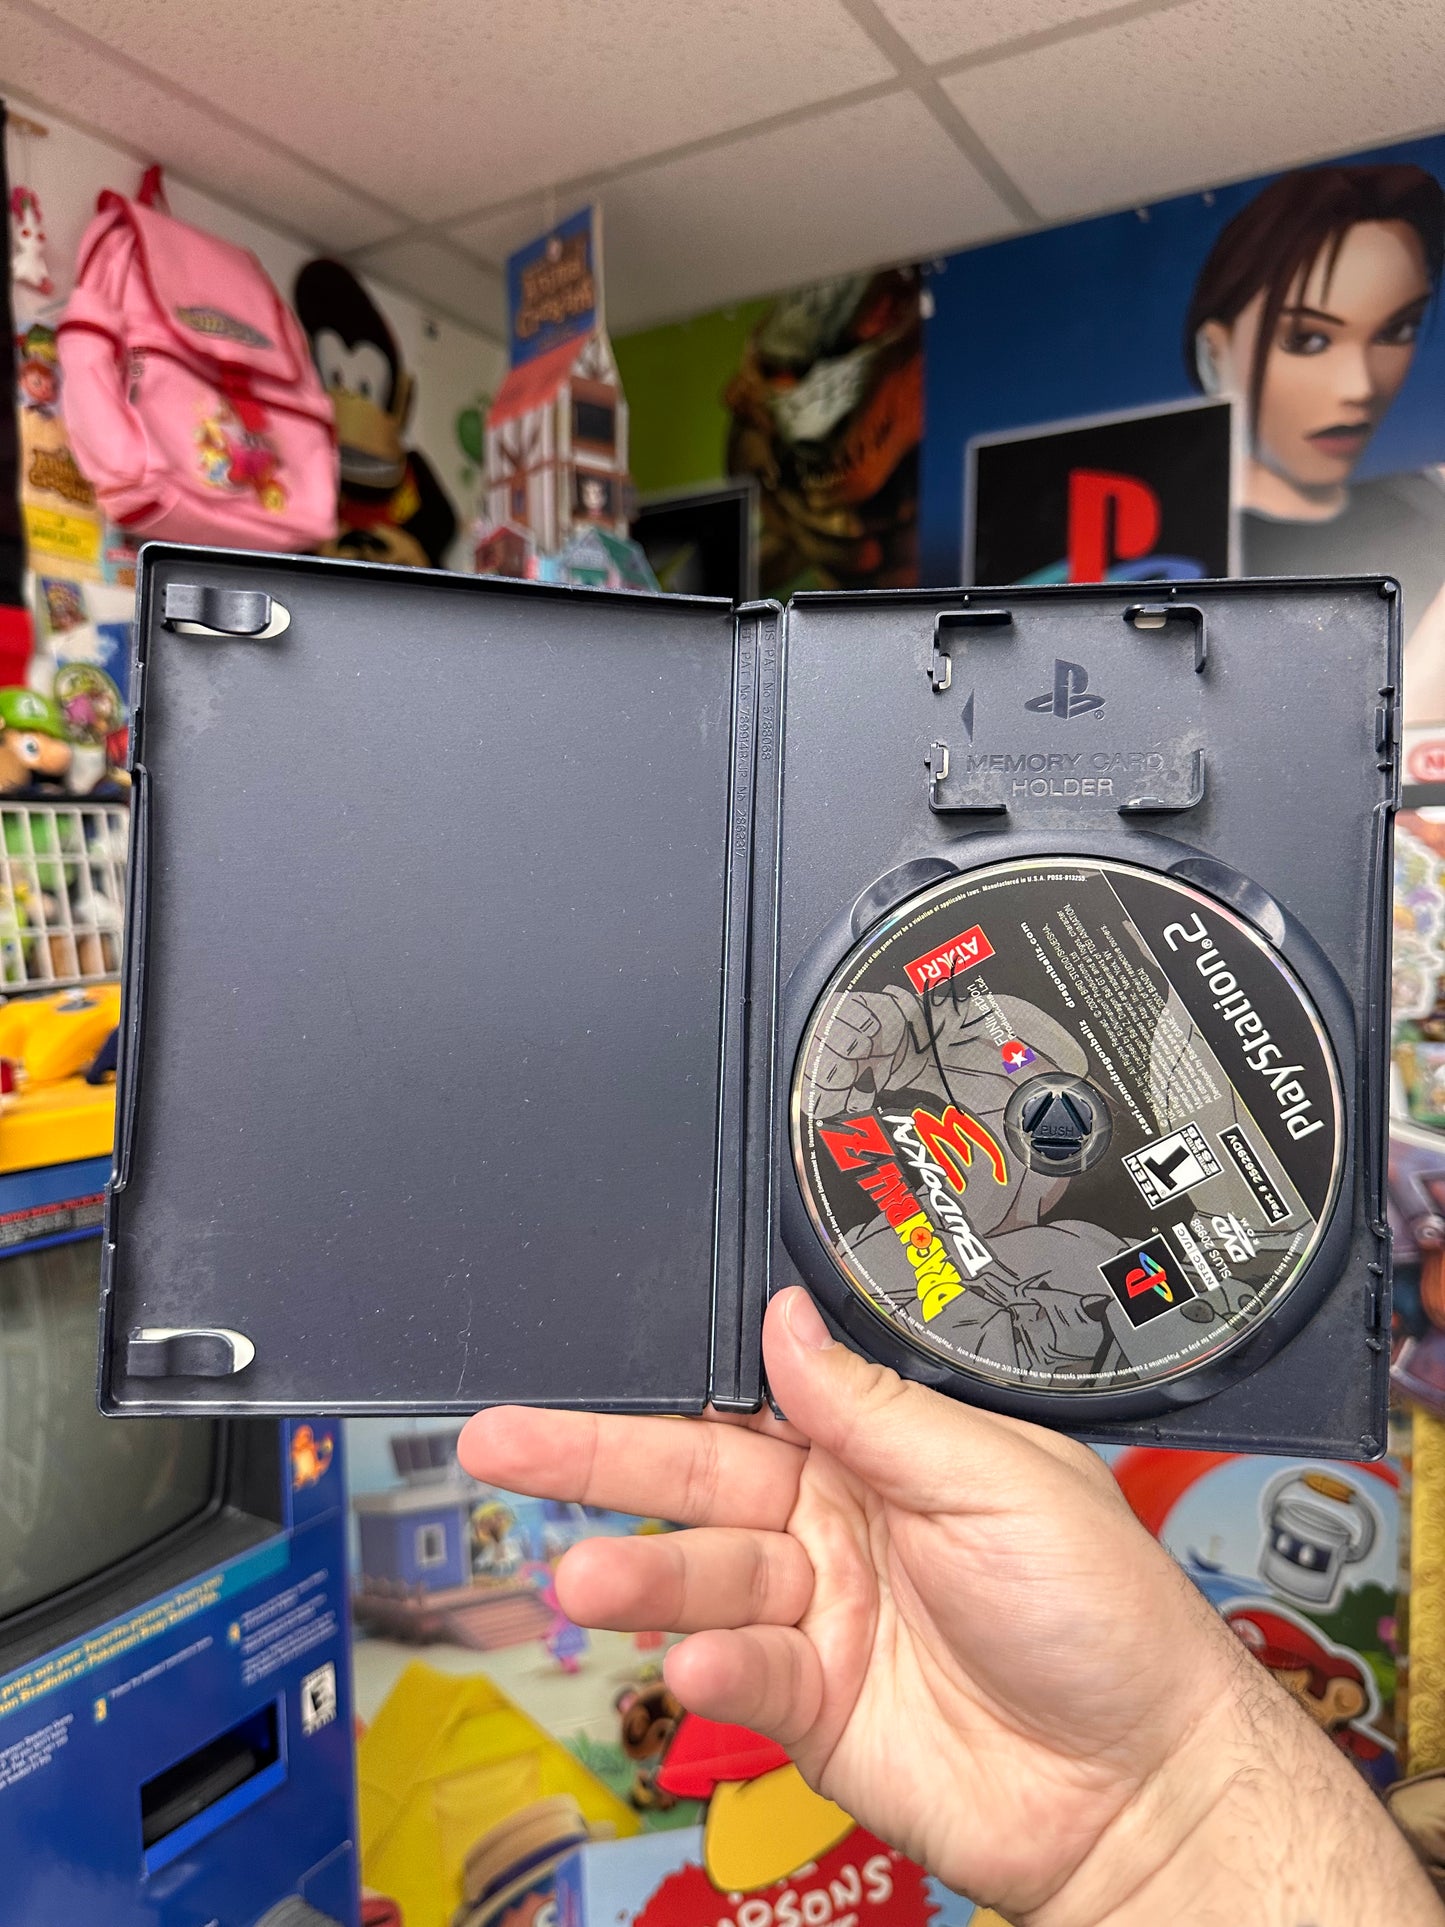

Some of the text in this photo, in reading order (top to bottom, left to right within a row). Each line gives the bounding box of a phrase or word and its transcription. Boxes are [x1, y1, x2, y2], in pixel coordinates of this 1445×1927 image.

[764, 624, 775, 641] US
[741, 652, 752, 674] PAT
[764, 650, 775, 671] PAT
[966, 752, 1164, 773] MEMORY CARD
[1011, 778, 1114, 797] HOLDER
[1055, 908, 1076, 938] character
[916, 935, 983, 982] ATARI
[1019, 921, 1076, 1009] dragonballz.com
[1092, 951, 1101, 960] of
[1088, 962, 1099, 975] and
[1097, 958, 1120, 991] trademarks
[974, 974, 988, 992] Ltd.
[1074, 978, 1088, 995] BIRD
[1101, 984, 1113, 998] Ball
[1118, 973, 1131, 989] New
[1083, 993, 1097, 1011] 2004
[1117, 990, 1127, 1001] are
[1139, 990, 1148, 1000] of
[1151, 991, 1165, 1008] 2004
[1109, 996, 1127, 1019] Dragon
[1125, 1024, 1137, 1038] Ball
[1145, 1018, 1155, 1028] by
[1120, 1033, 1131, 1044] by
[1133, 1036, 1151, 1060] Dragon
[1114, 1045, 1132, 1067] Rights
[1125, 1042, 1145, 1070] Licensed
[1192, 1058, 1203, 1068] by
[1077, 1019, 1153, 1136] atari.com/dragonballz
[1126, 1064, 1136, 1075] All
[1175, 1107, 1186, 1118] All
[1040, 1125, 1073, 1136] PUSH
[818, 1114, 895, 1170] Z
[911, 1104, 1005, 1193] 3
[1181, 1128, 1211, 1175] CONTENT RATED BY
[1187, 1124, 1219, 1172] ESRB
[1143, 1145, 1189, 1189] T
[1226, 1132, 1283, 1218] Part # 25629DV
[1126, 1156, 1160, 1204] TEEN
[882, 1115, 993, 1276] BUDOKAI
[1190, 1217, 1232, 1278] SLUS 20998
[1208, 1214, 1249, 1265] DVD
[1176, 1227, 1214, 1285] NTSC U/C
